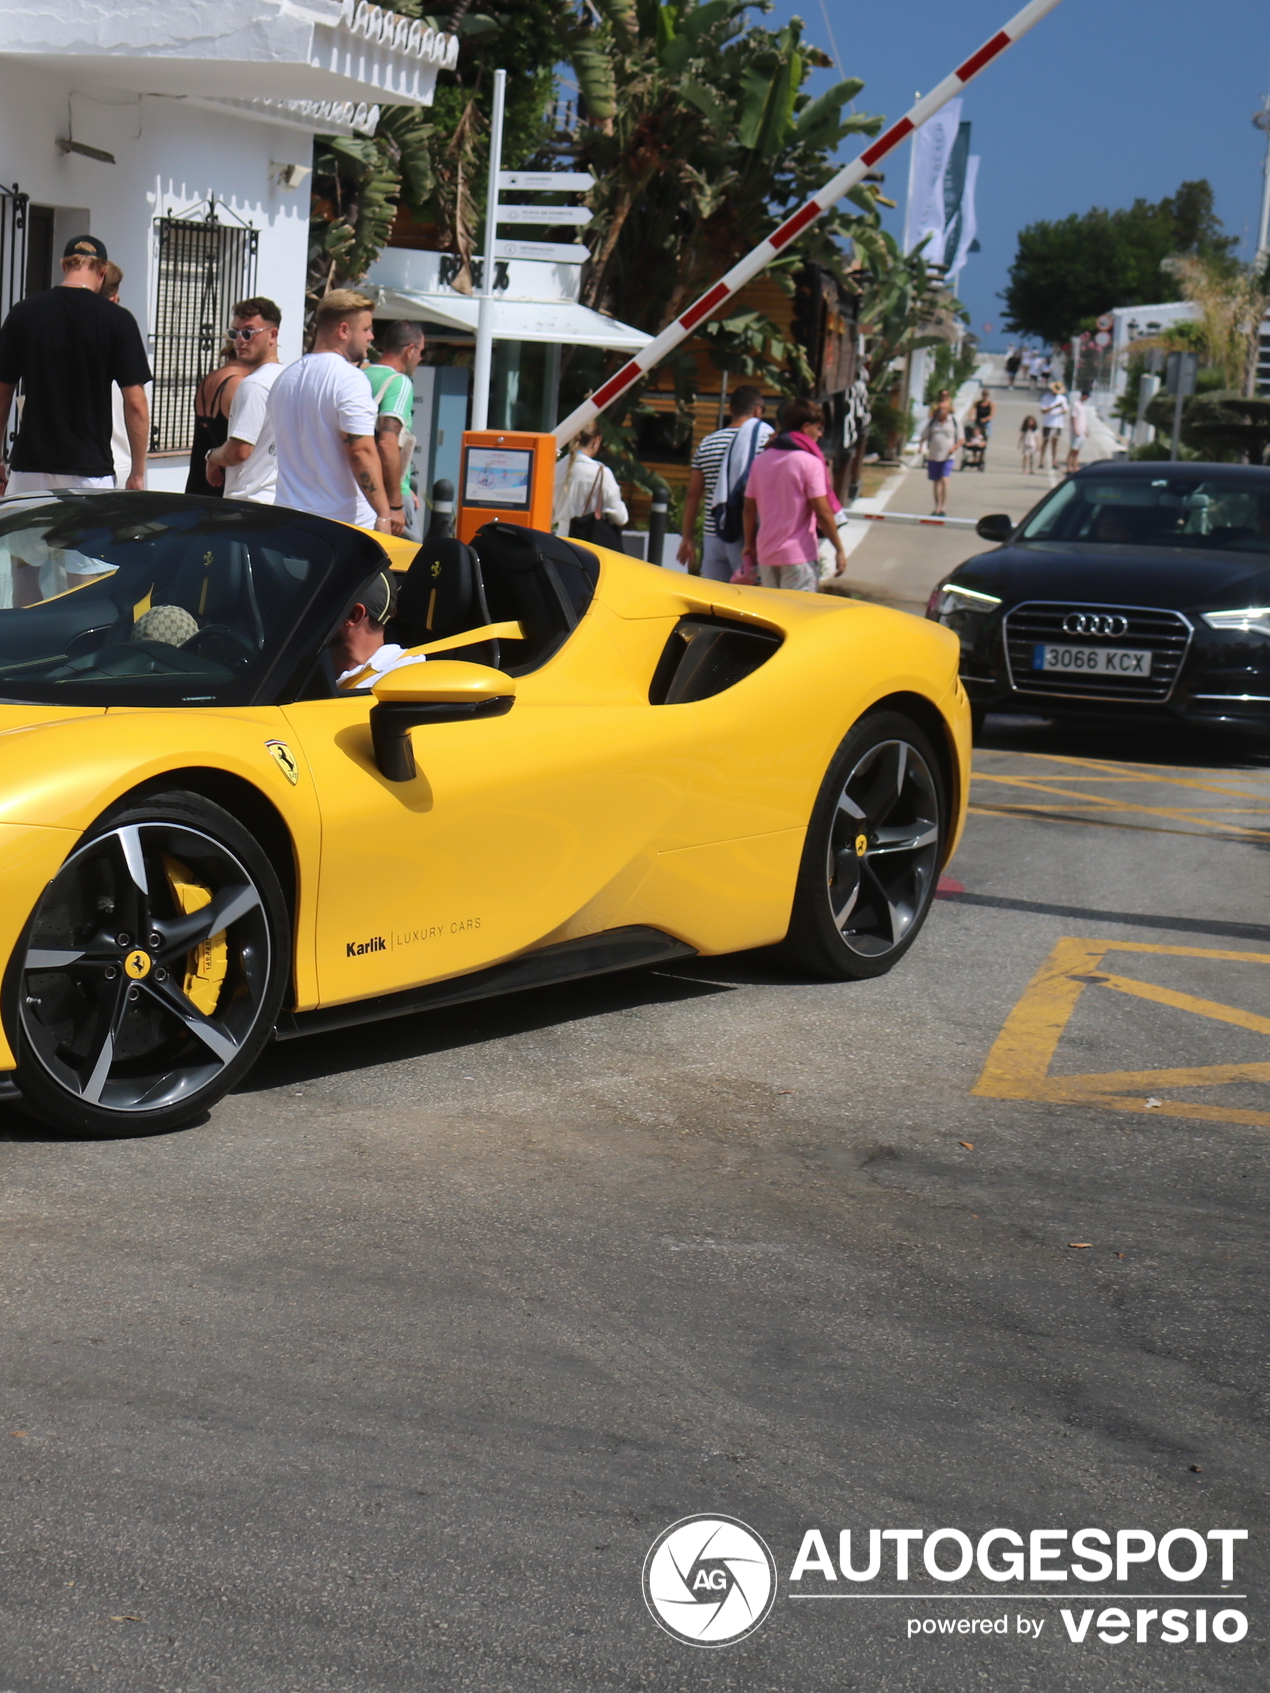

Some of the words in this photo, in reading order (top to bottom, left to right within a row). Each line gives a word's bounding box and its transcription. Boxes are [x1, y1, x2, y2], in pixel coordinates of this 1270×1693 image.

[1048, 649, 1098, 669] 3066
[1106, 653, 1144, 672] KCX
[346, 936, 386, 957] Karlik
[397, 925, 444, 945] LUXURY
[450, 917, 481, 934] CARS
